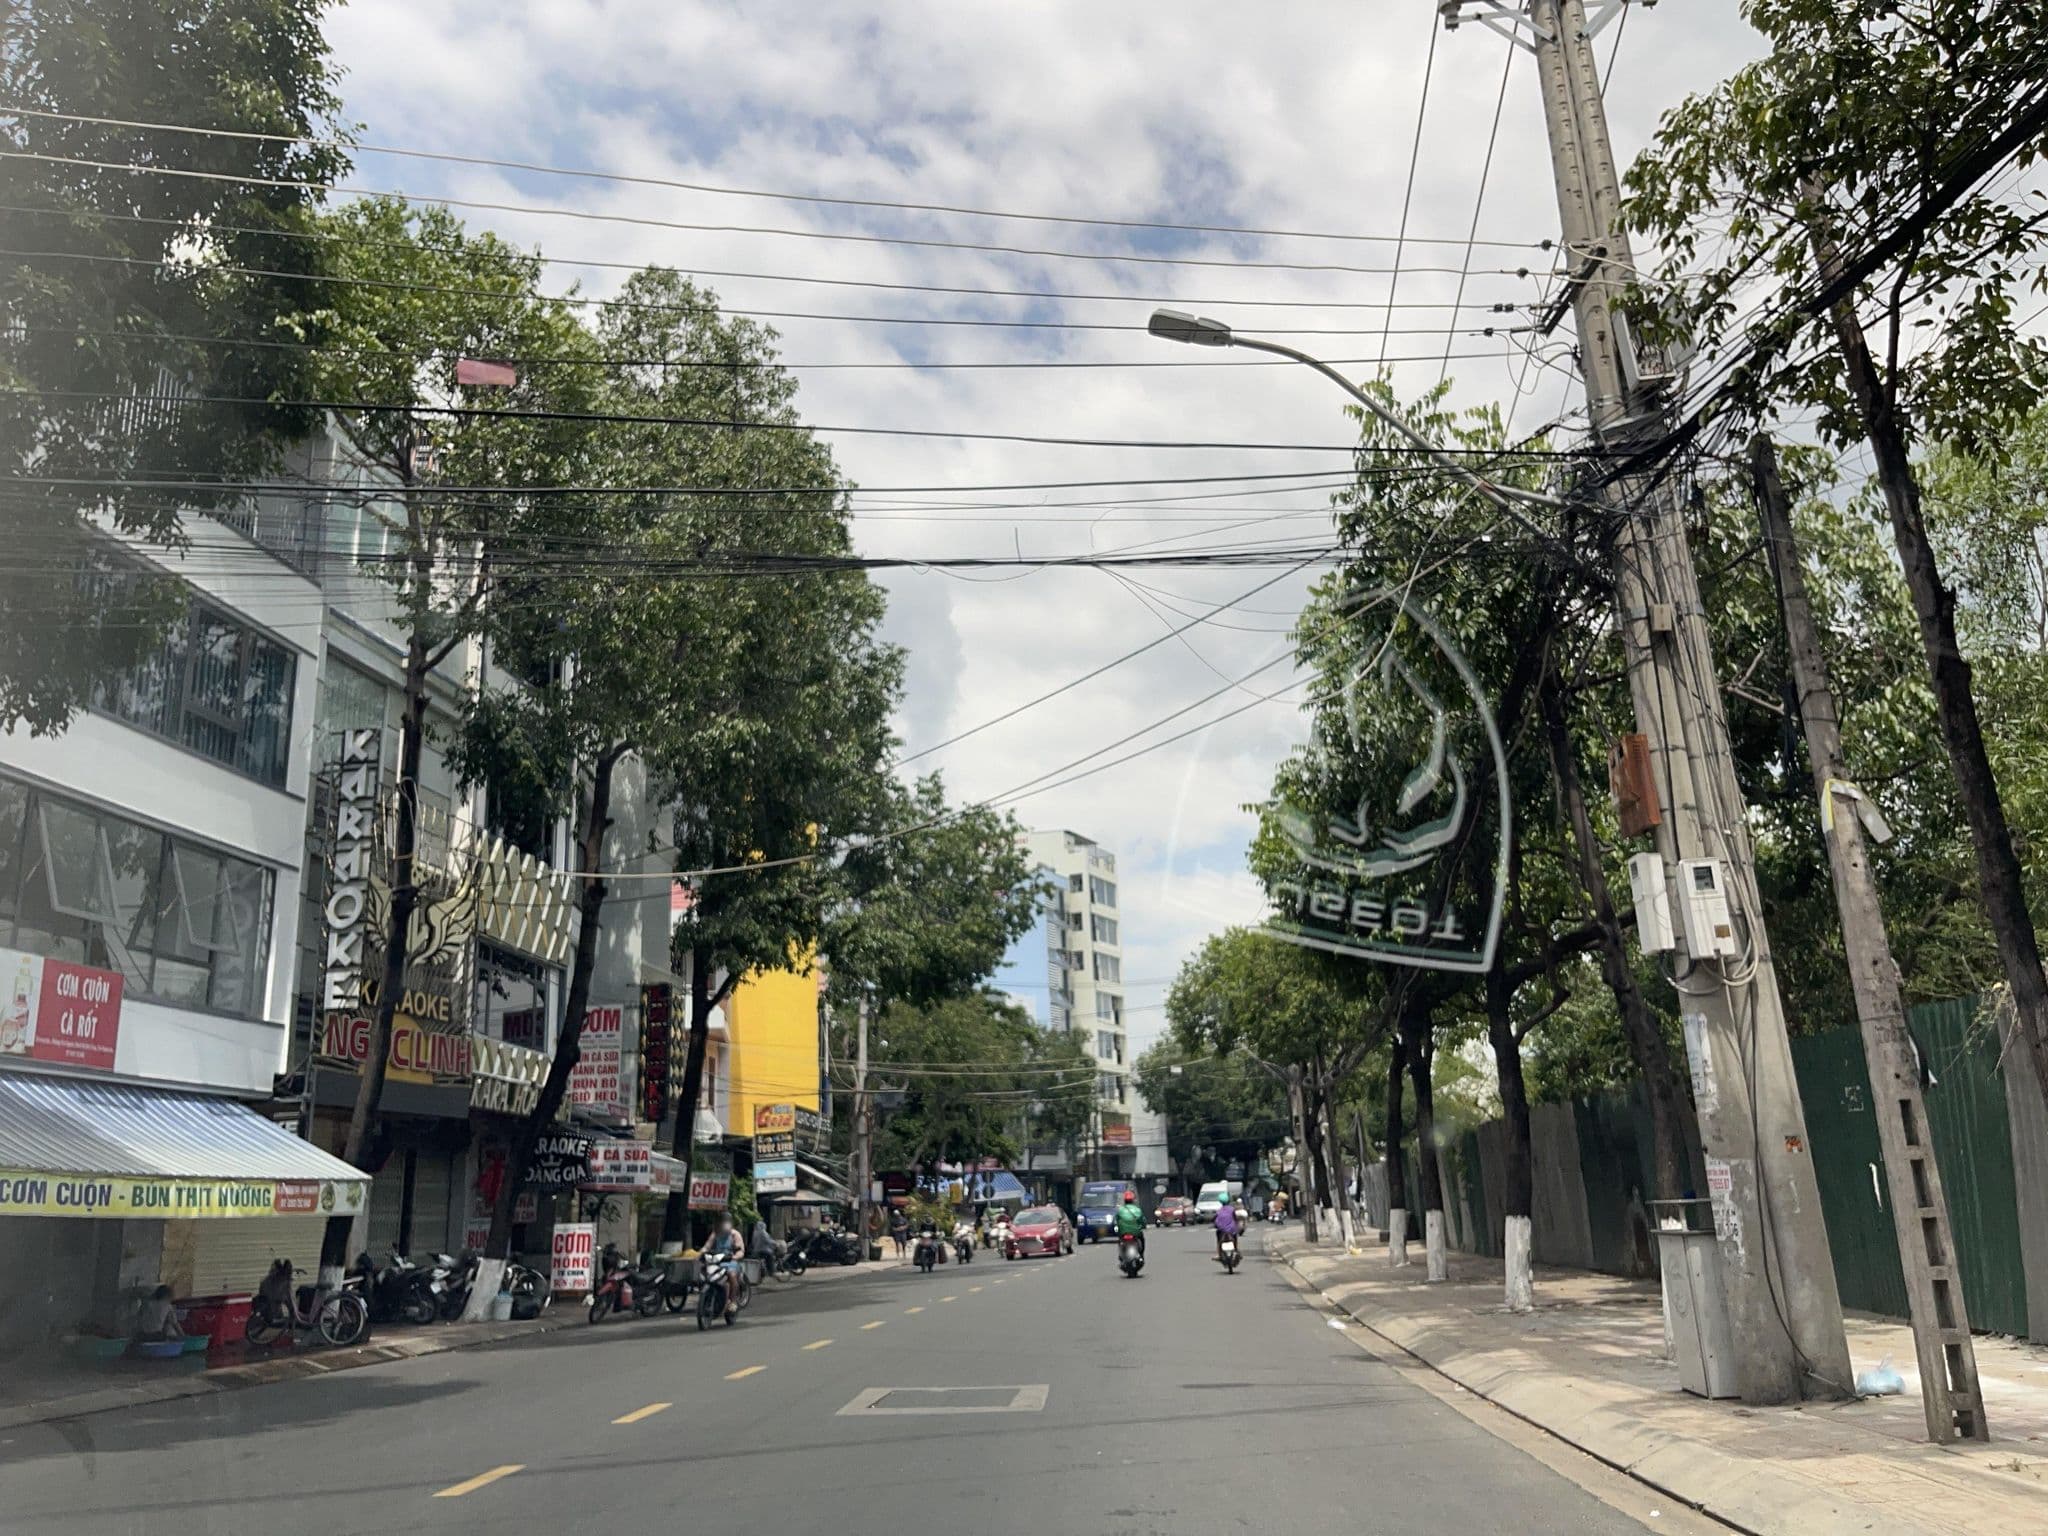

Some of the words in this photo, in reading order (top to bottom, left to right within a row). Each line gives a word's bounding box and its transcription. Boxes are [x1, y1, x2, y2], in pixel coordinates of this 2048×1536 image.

[324, 729, 374, 1010] KARAOKE
[56, 972, 79, 998] CƠM
[82, 975, 110, 1008] CUỘN
[60, 1008, 73, 1035] CÀ
[77, 1008, 98, 1039] RỐT
[325, 1013, 411, 1070] NGC
[56, 1180, 112, 1212] CUỘN
[131, 1182, 170, 1208] BÚN
[692, 1180, 727, 1199] CƠM
